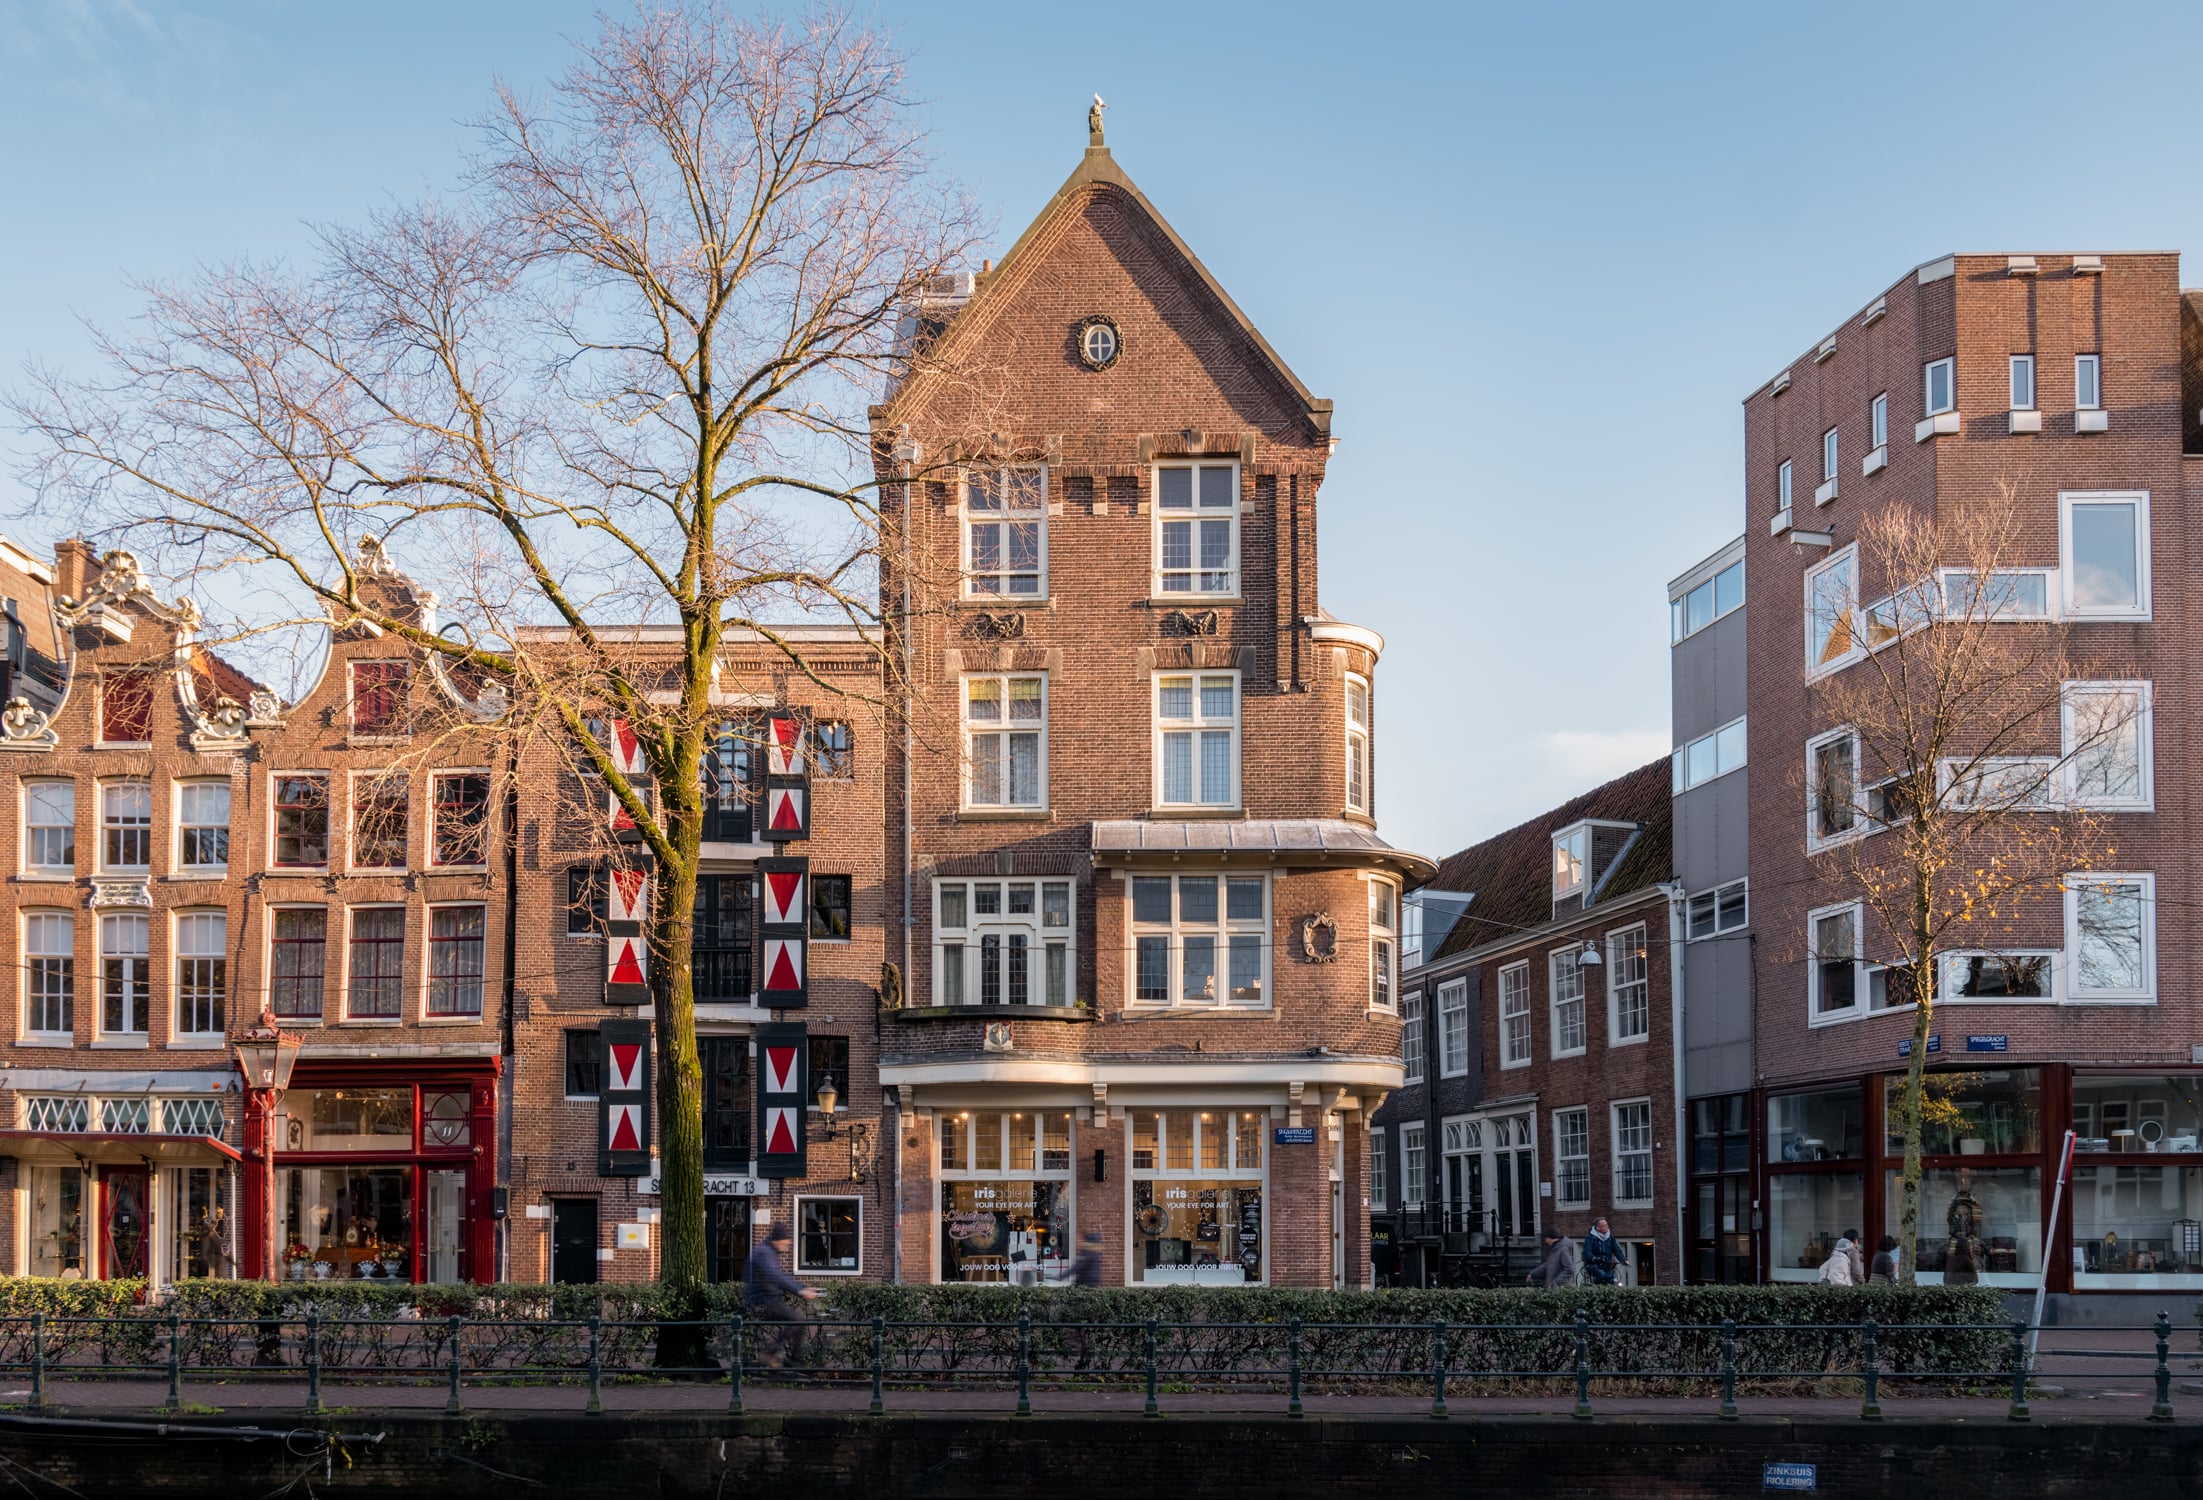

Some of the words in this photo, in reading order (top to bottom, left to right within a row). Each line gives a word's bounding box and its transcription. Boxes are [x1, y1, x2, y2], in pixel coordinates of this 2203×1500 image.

[744, 1181, 755, 1193] 13
[975, 1201, 994, 1209] YOUR
[995, 1201, 1008, 1209] EYE
[1009, 1201, 1023, 1209] FOR
[1024, 1201, 1038, 1209] ART
[960, 1263, 982, 1271] JOUW
[983, 1263, 1001, 1271] OOG
[1153, 1263, 1176, 1271] JOUW
[1177, 1263, 1196, 1271] OOG
[1196, 1263, 1218, 1271] VOOR
[1218, 1263, 1243, 1271] KUNST
[1767, 1466, 1813, 1477] ZINKBUIS
[1766, 1477, 1813, 1487] RIOLERING
